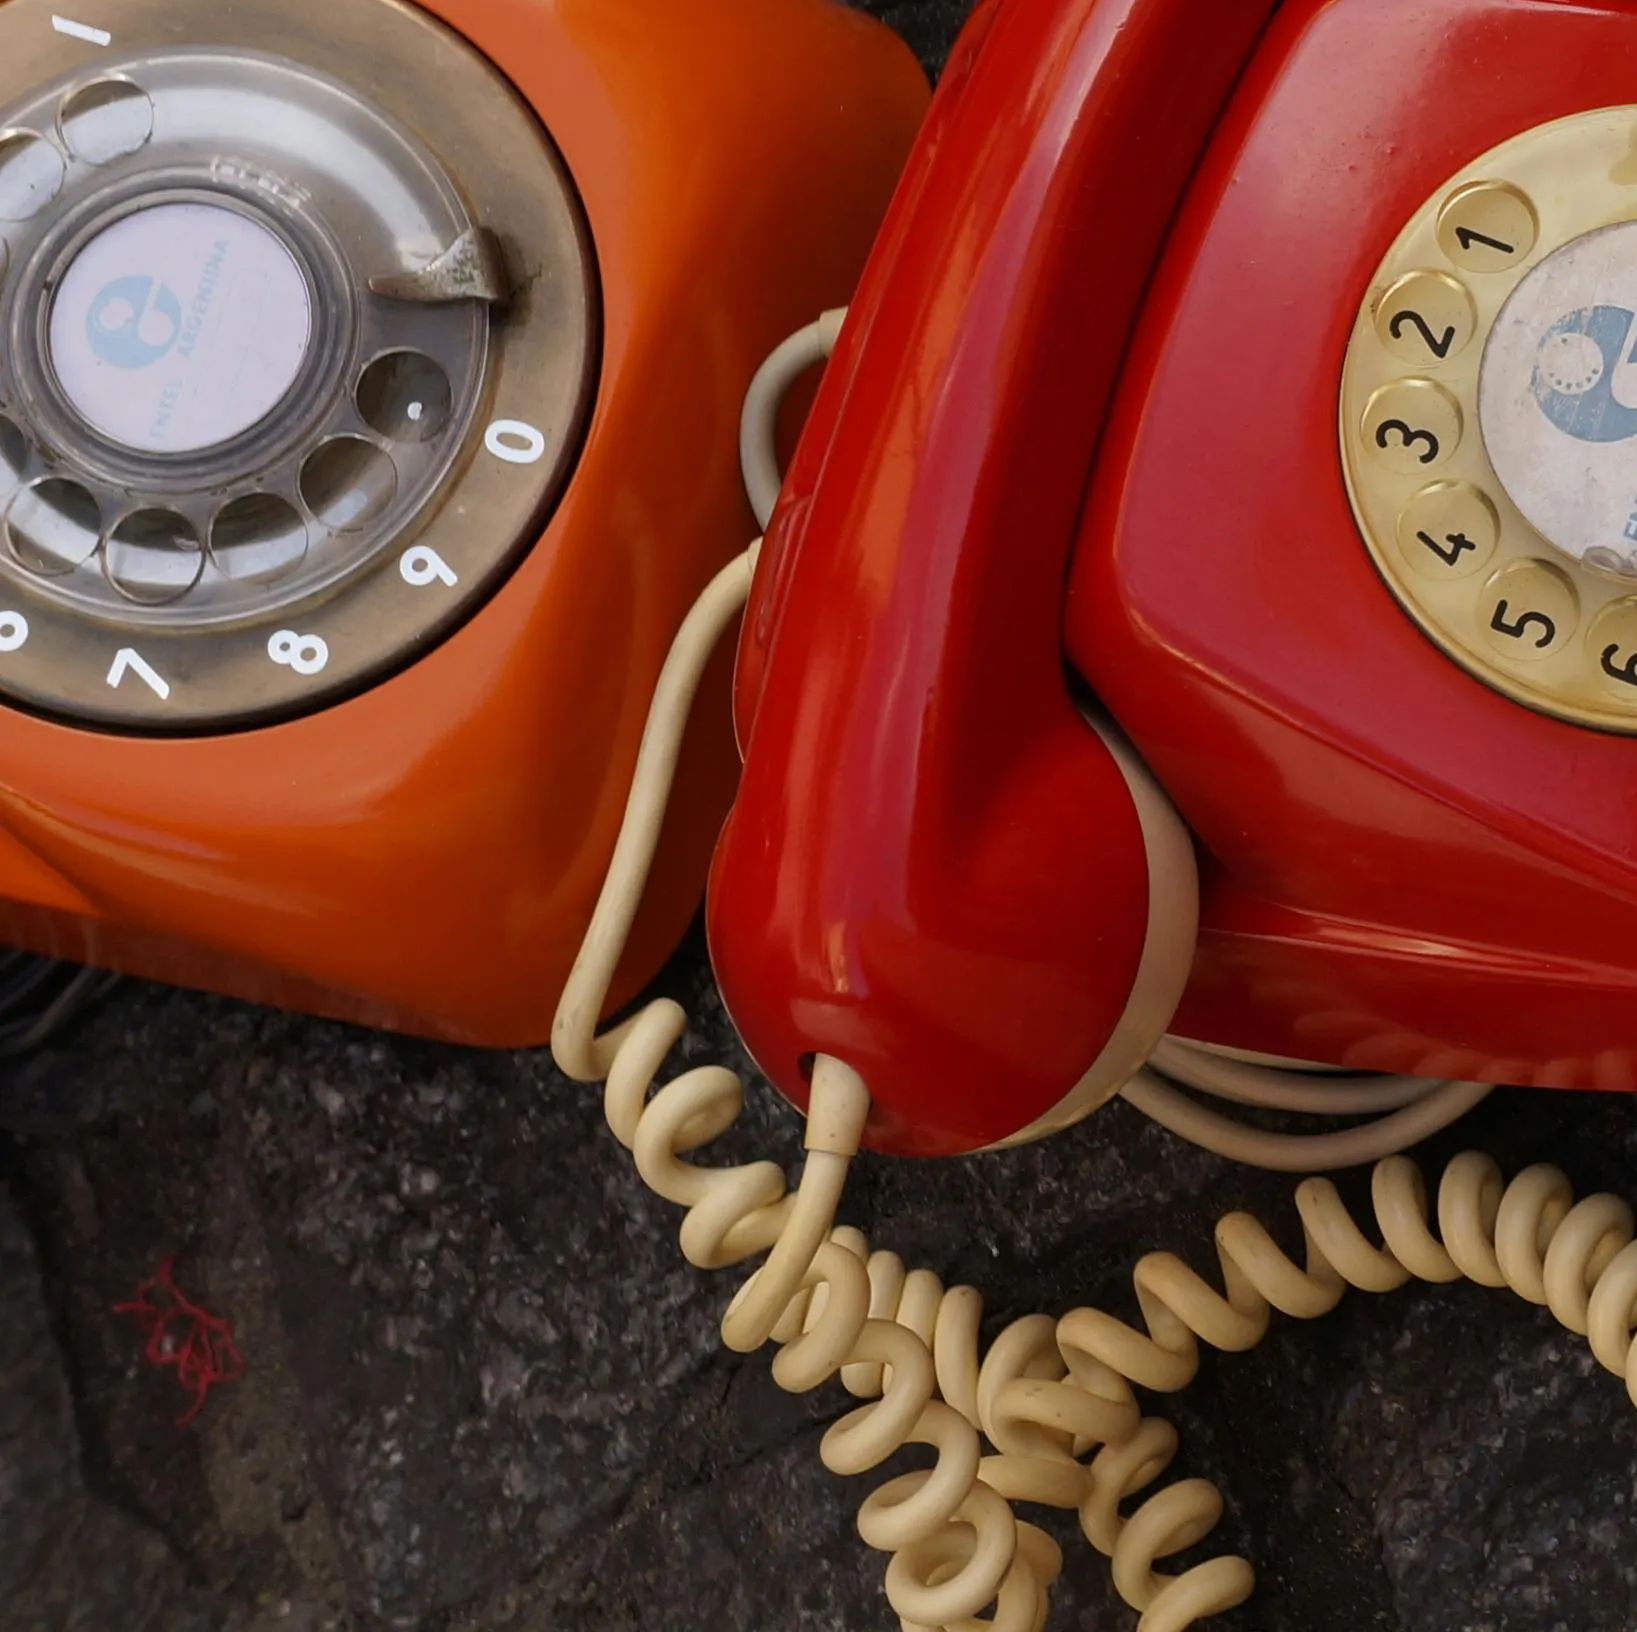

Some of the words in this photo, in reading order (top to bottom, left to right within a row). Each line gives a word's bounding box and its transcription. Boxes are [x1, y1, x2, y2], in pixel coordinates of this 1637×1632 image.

[1455, 226, 1514, 254] 1
[52, 14, 111, 45] 1
[106, 648, 170, 700] 7
[268, 629, 329, 674] 8
[400, 545, 458, 587] 9
[485, 419, 545, 463] 0
[149, 379, 184, 438] ENTEL
[177, 238, 230, 359] ARGENTINA
[1390, 310, 1455, 358] 2
[1375, 419, 1439, 463] 3
[1416, 531, 1476, 566] 4
[1490, 600, 1556, 649] 5
